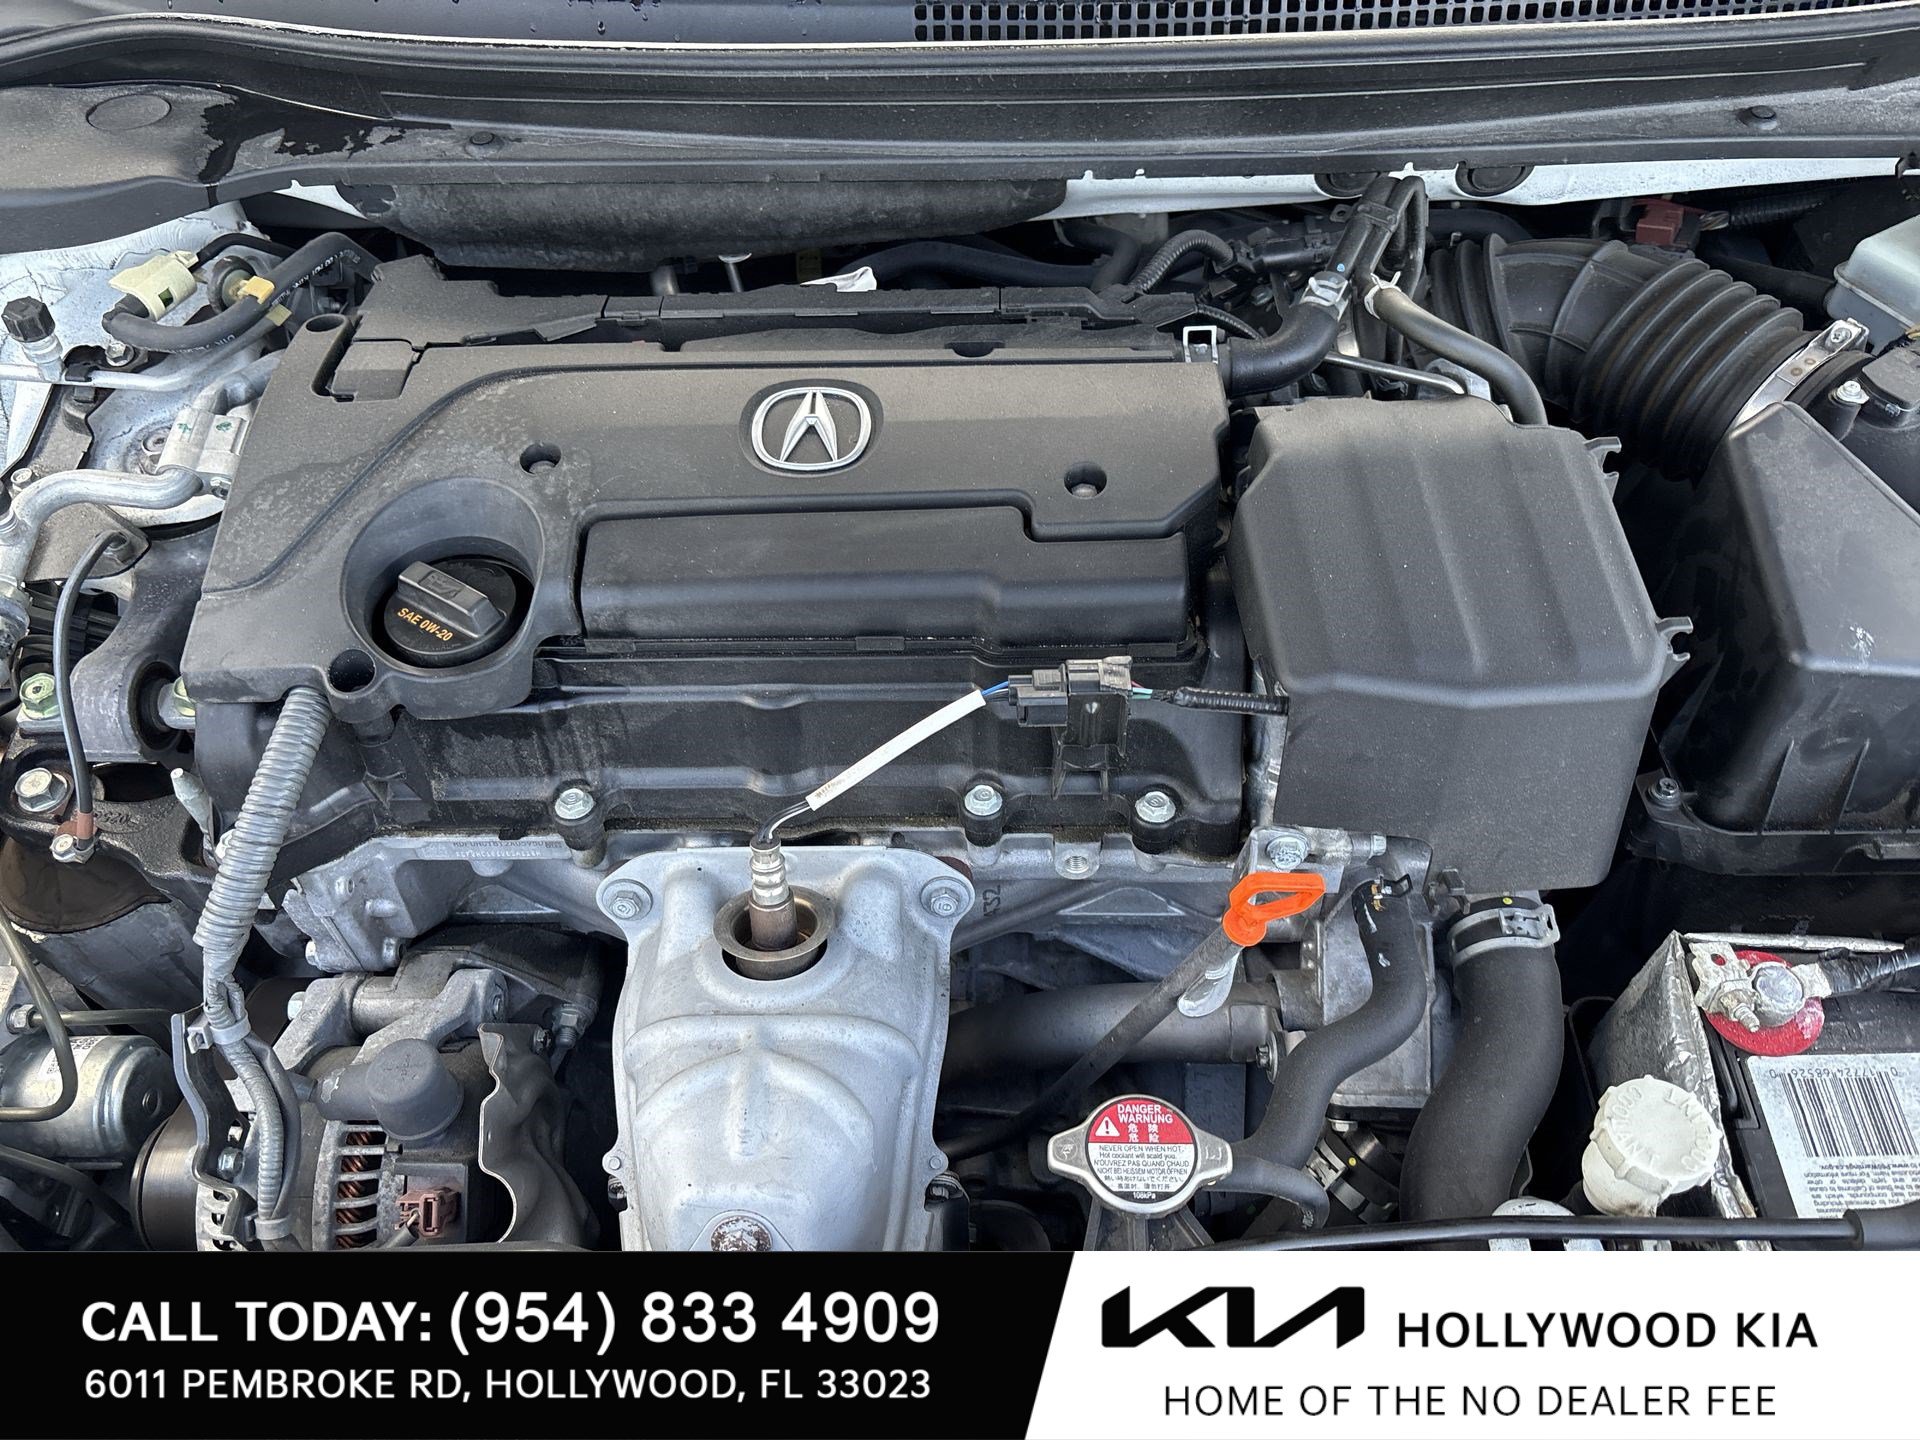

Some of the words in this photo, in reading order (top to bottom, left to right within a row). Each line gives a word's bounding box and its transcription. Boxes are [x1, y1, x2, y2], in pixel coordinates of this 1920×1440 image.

[397, 607, 423, 625] SAE
[420, 618, 454, 641] 0W-20
[1769, 1068, 1778, 1079] 0
[1791, 1067, 1831, 1078] 68526
[1837, 1069, 1875, 1077] 17724
[1890, 1066, 1898, 1077] 0
[1117, 1104, 1162, 1114] DANGER
[1118, 1113, 1174, 1124] WARNUNG
[1099, 1144, 1123, 1152] NEVER
[1124, 1144, 1143, 1152] OPEN
[1144, 1144, 1166, 1152] WHEN
[1147, 1152, 1164, 1160] scald
[1094, 1159, 1127, 1167] N'OUVREZ
[1142, 1160, 1166, 1168] QUAND
[1132, 1191, 1157, 1200] 108kPa
